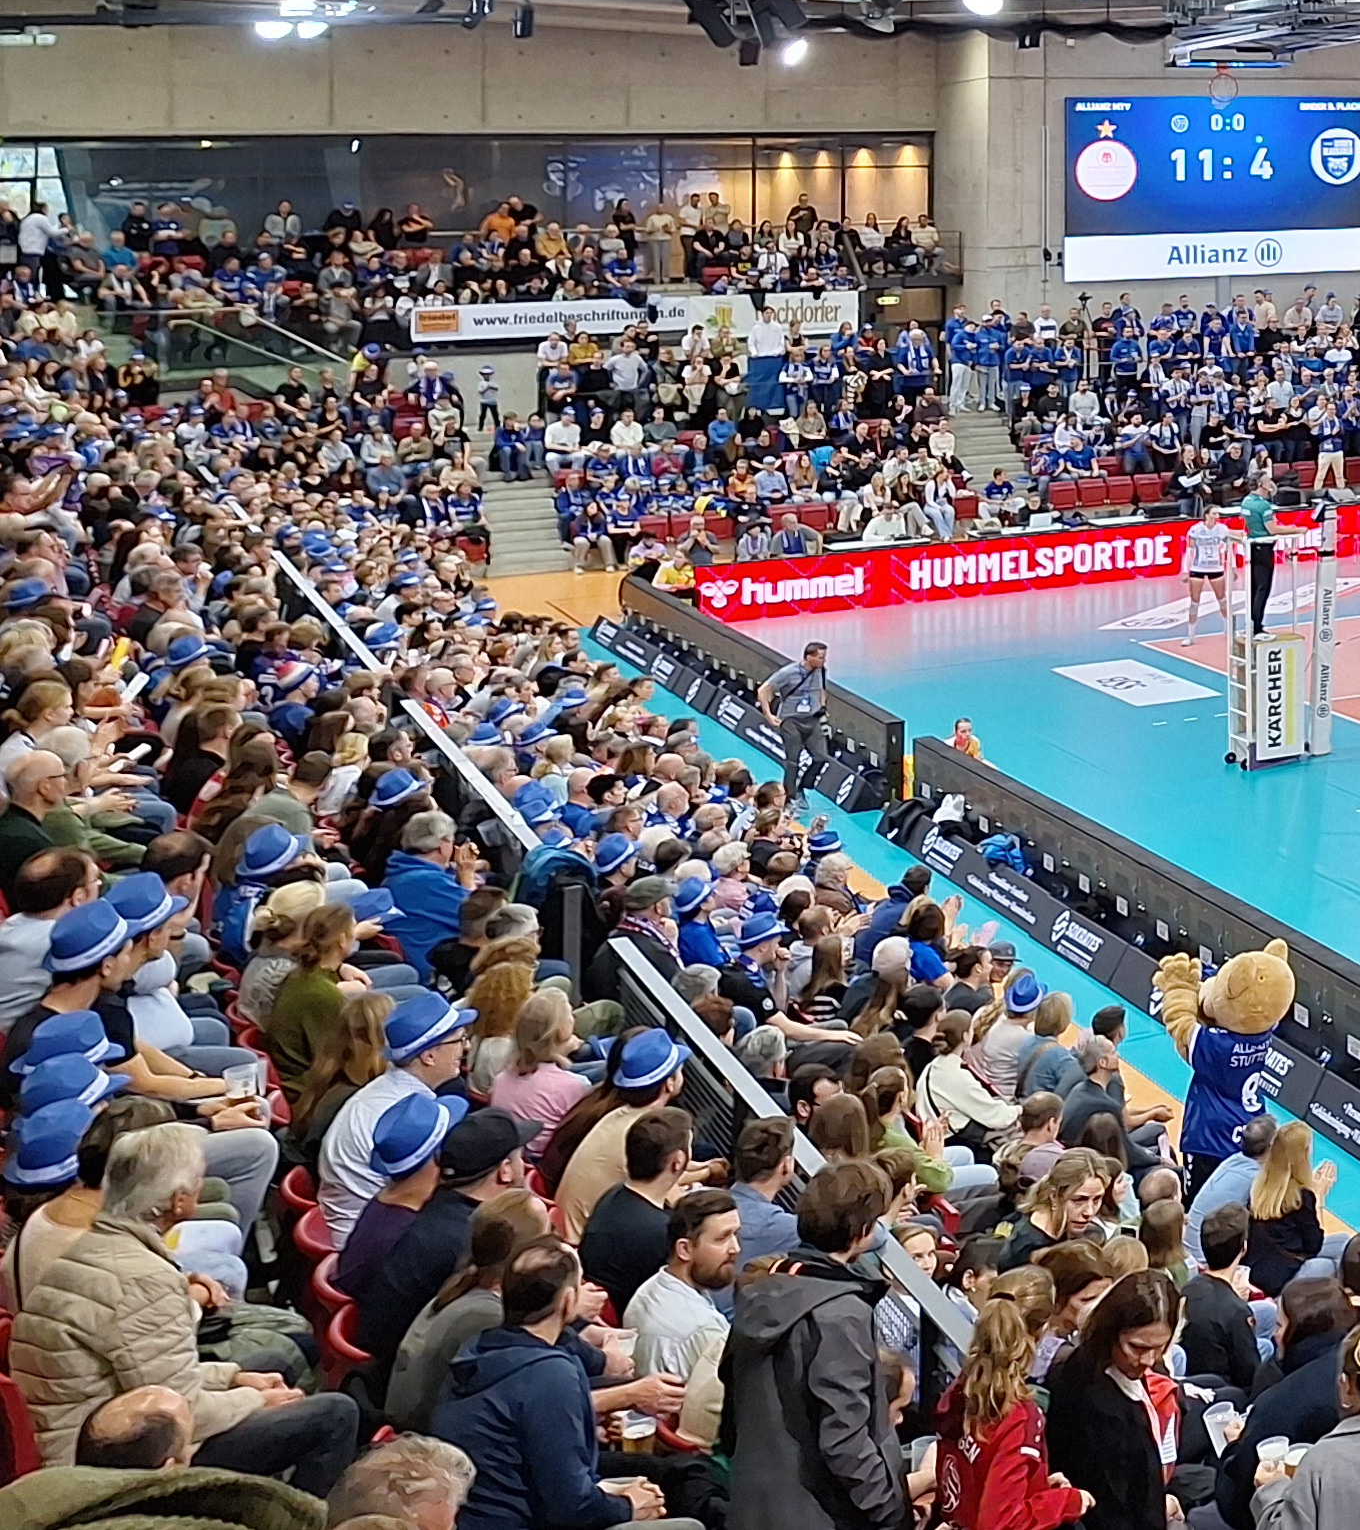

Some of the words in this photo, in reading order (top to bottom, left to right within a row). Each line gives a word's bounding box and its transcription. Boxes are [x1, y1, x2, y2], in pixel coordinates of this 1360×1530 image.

[1211, 113, 1245, 131] 0:0
[1250, 146, 1274, 180] 4
[1167, 245, 1249, 266] Allianz
[742, 568, 865, 606] hummel
[910, 535, 1174, 591] HUMMELSPORT.DE
[1323, 588, 1333, 627] Allianz
[1267, 648, 1282, 749] KÄRCHER
[1319, 664, 1330, 702] Allianz
